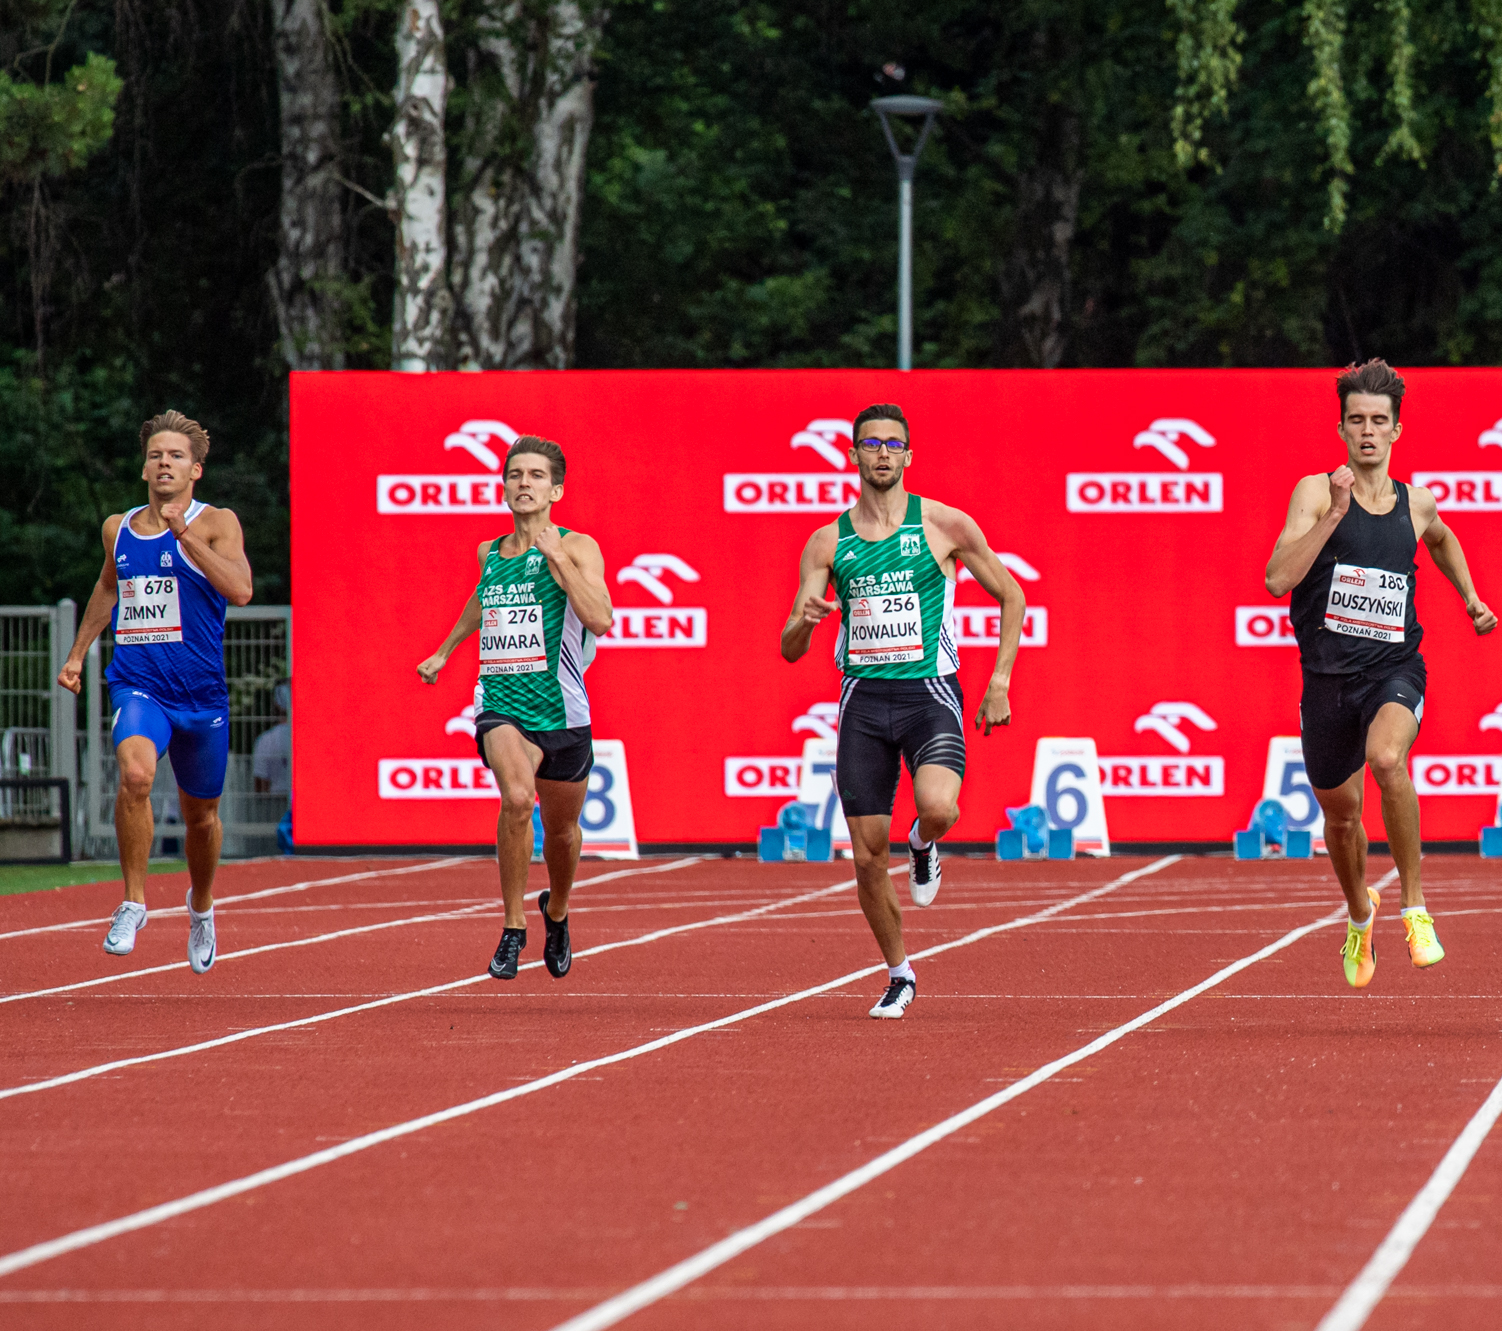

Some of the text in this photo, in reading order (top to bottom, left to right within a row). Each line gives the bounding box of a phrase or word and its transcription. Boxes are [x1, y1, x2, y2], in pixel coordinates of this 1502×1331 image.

[1077, 480, 1211, 505] ORLEN
[144, 579, 174, 595] 678
[849, 569, 915, 589] AZS AWF
[482, 582, 536, 597] AZS AWF
[849, 581, 915, 598] WARSZAWA
[482, 593, 536, 607] WARSZAWA
[882, 596, 915, 614] 256
[1331, 590, 1403, 618] DUSZYŃSKI
[123, 604, 167, 621] ZIMNY
[508, 608, 538, 625] 276
[152, 634, 169, 642] 2021
[851, 621, 918, 641] KOWALUK
[1336, 623, 1372, 637] POZNAŃ
[1373, 630, 1391, 641] 2021
[481, 633, 542, 651] SUWARA
[893, 653, 911, 661] 2021
[517, 664, 534, 672] 2021
[389, 766, 493, 790] ORLE
[579, 763, 616, 832] 8
[1046, 762, 1088, 830] 6
[1279, 761, 1320, 827] 5
